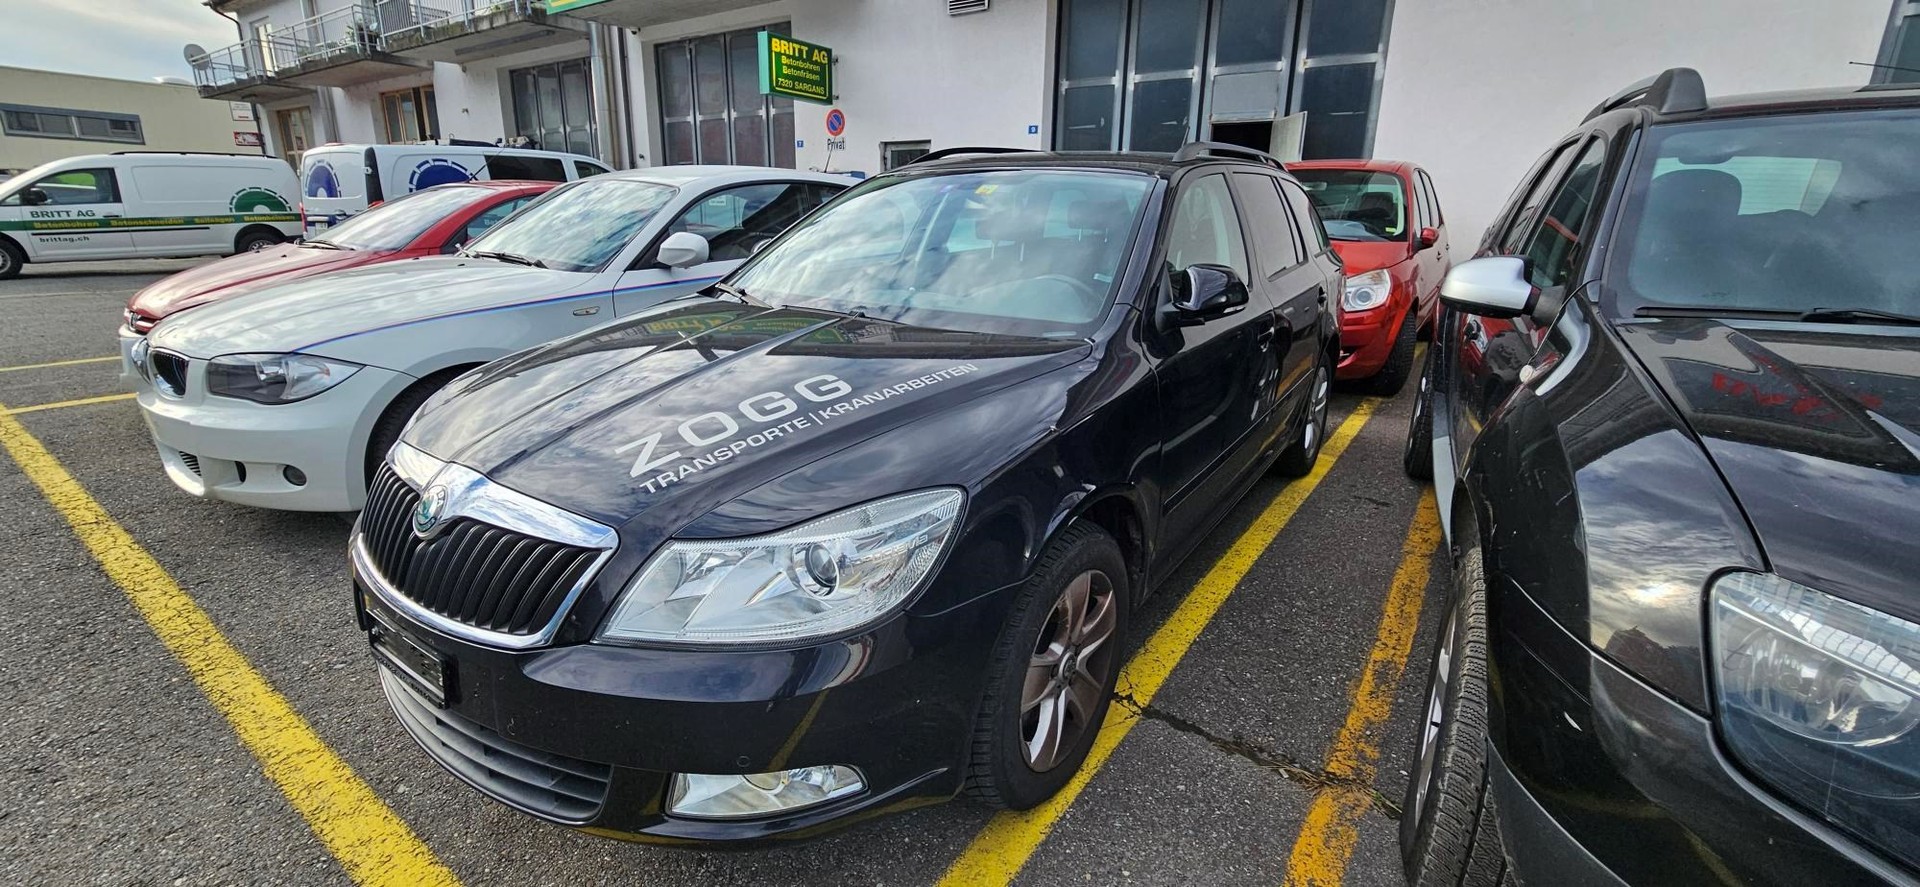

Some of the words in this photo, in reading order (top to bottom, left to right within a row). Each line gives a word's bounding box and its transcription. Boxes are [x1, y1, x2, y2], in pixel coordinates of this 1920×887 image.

[771, 38, 808, 58] BRITT
[812, 49, 828, 64] AG
[781, 56, 820, 71] Betonbohren
[782, 65, 820, 80] Betonfräsen
[778, 78, 793, 87] 7320
[794, 81, 825, 95] SARGANS
[30, 210, 72, 219] BRITT
[40, 235, 90, 243] brittag.ch
[615, 374, 852, 478] ZOGG
[640, 415, 811, 494] TRANSPORTE
[820, 363, 979, 420] KRANARBEITEN
